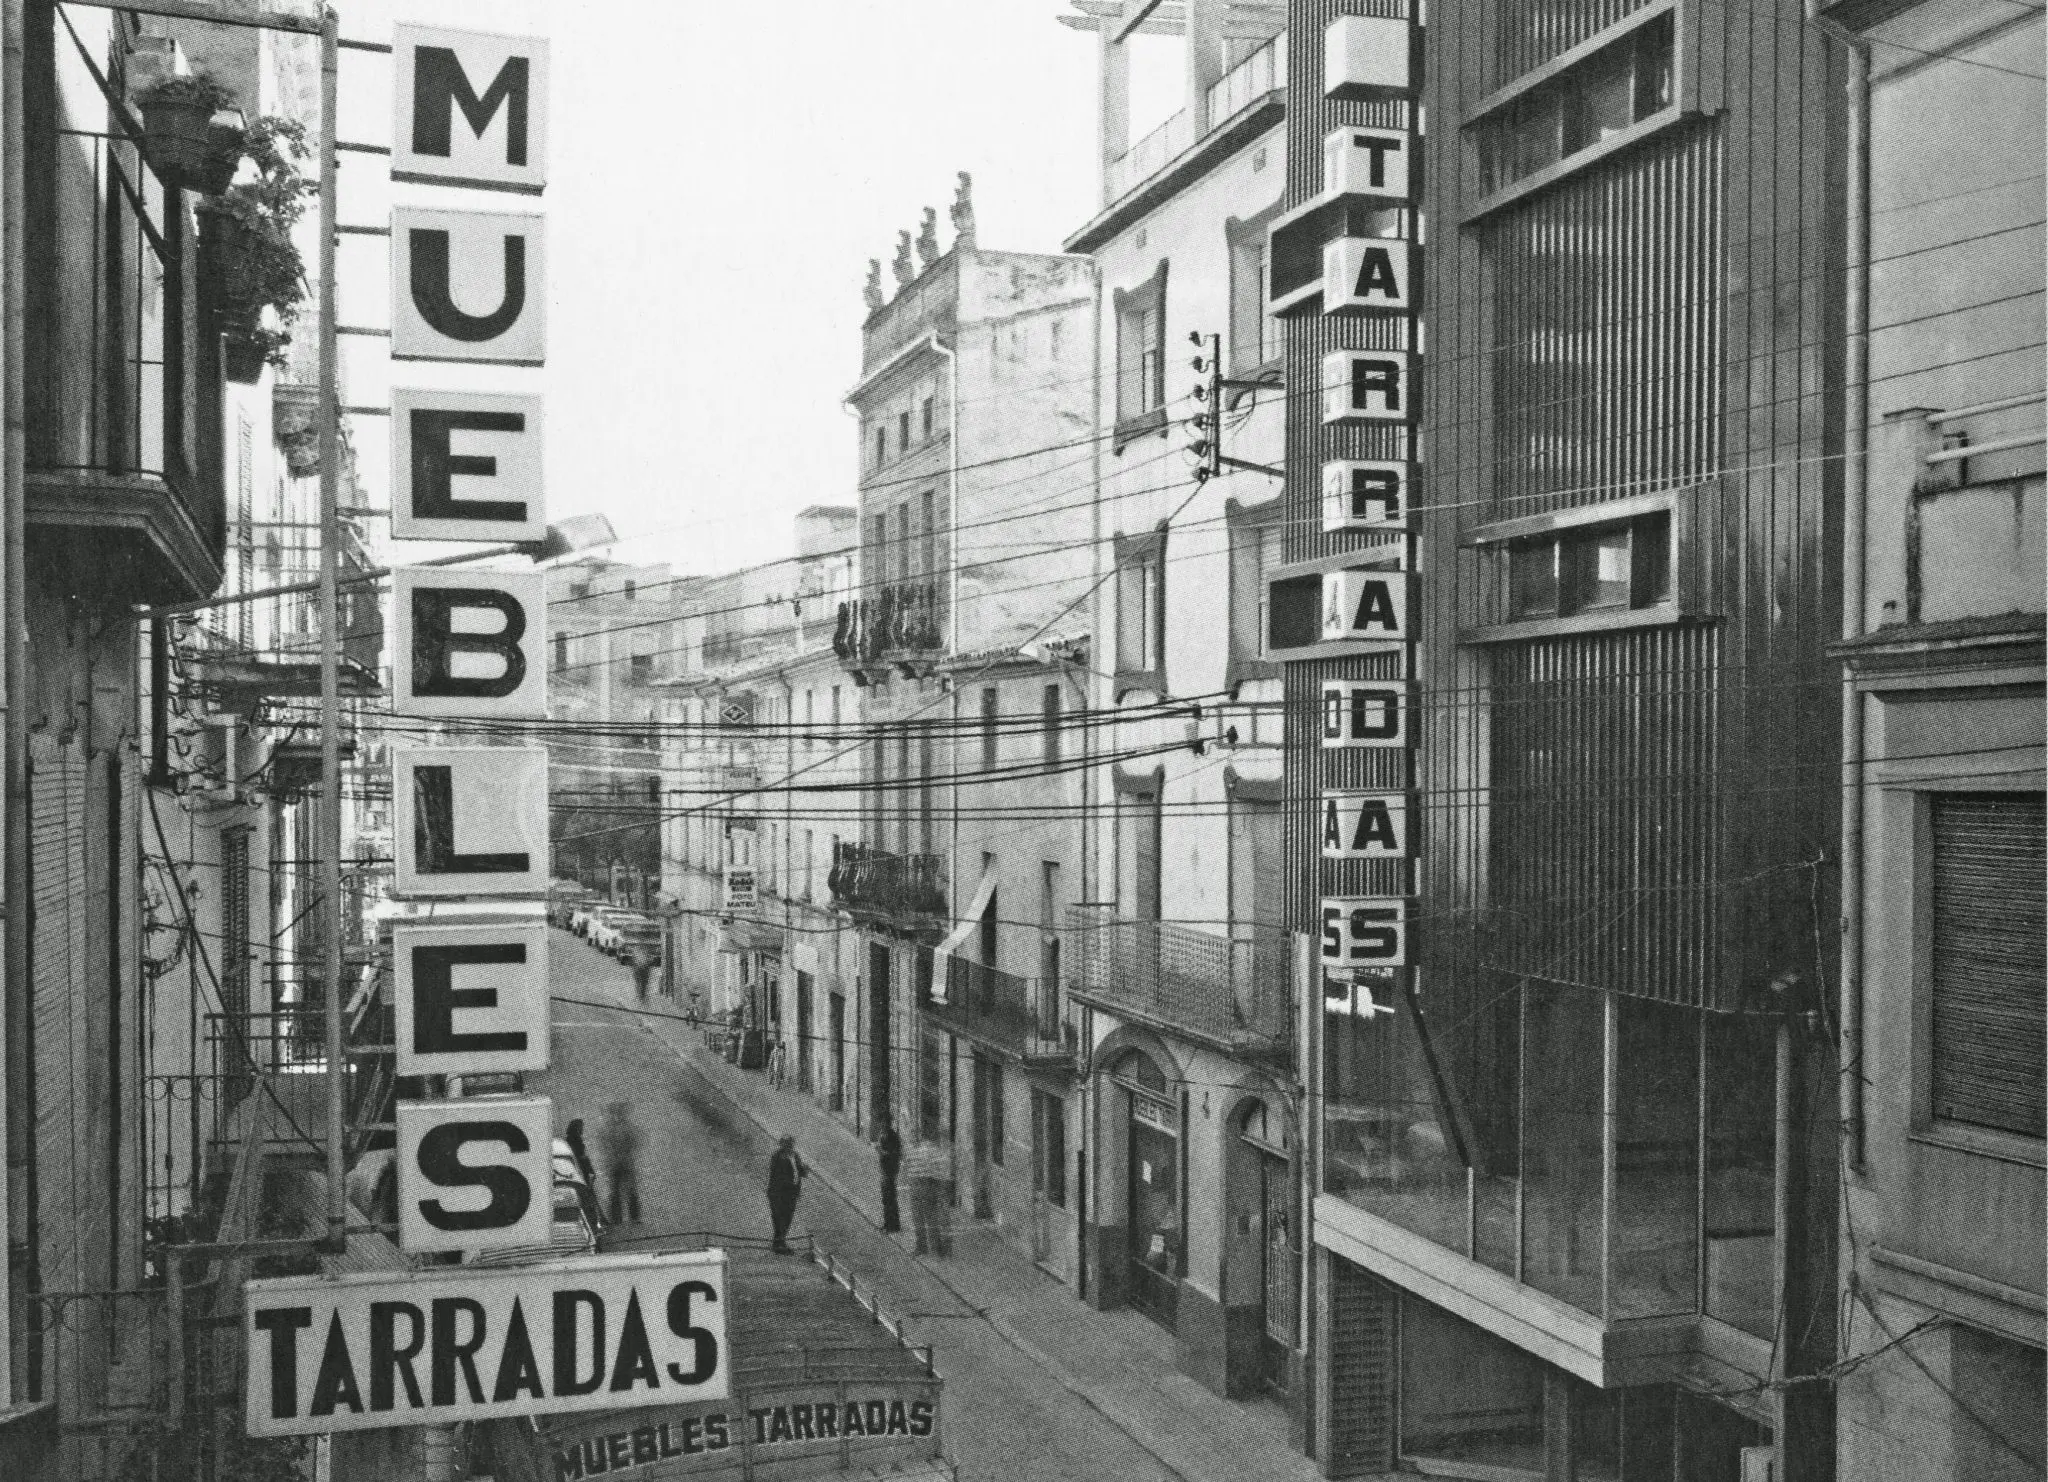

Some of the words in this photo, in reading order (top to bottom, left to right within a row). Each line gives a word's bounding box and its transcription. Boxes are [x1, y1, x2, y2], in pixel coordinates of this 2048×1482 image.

[409, 44, 531, 1230] MUEBLES
[1350, 135, 1401, 959] TARRADAS
[254, 1280, 719, 1419] TARRADAS
[551, 1413, 730, 1481] MUEBLES
[747, 1399, 934, 1446] TARRADAS
